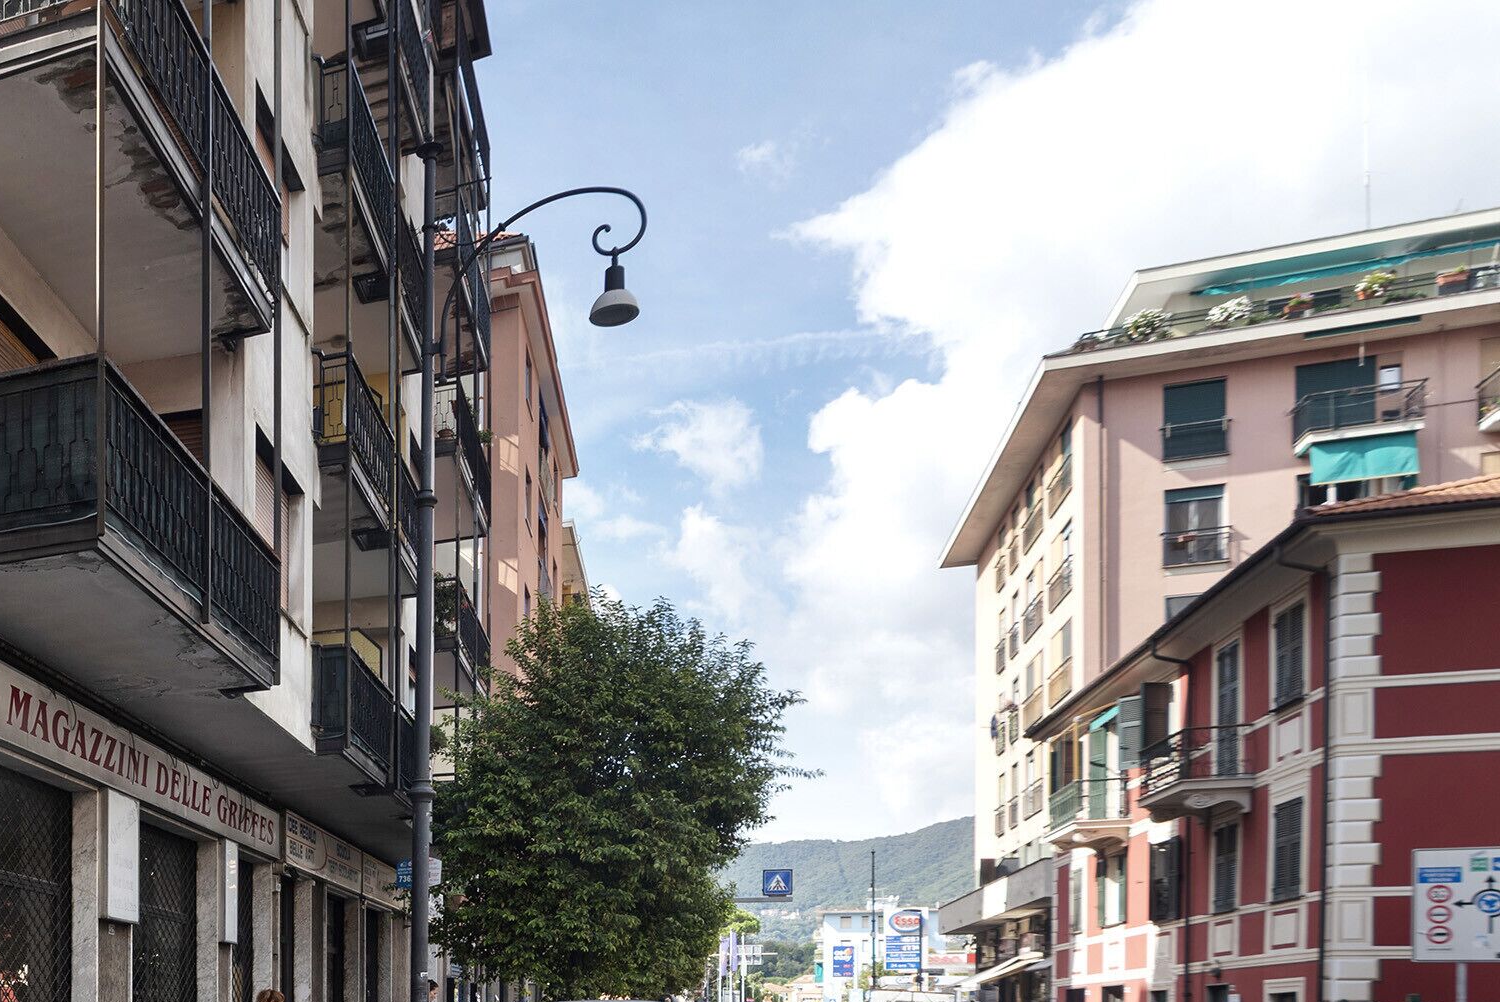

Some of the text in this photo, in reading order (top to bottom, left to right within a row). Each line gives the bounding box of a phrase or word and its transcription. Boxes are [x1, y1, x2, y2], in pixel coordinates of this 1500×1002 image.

[6, 684, 150, 790] MAGAZZINI
[156, 764, 212, 817] DELLE
[216, 798, 275, 847] GRIFFES
